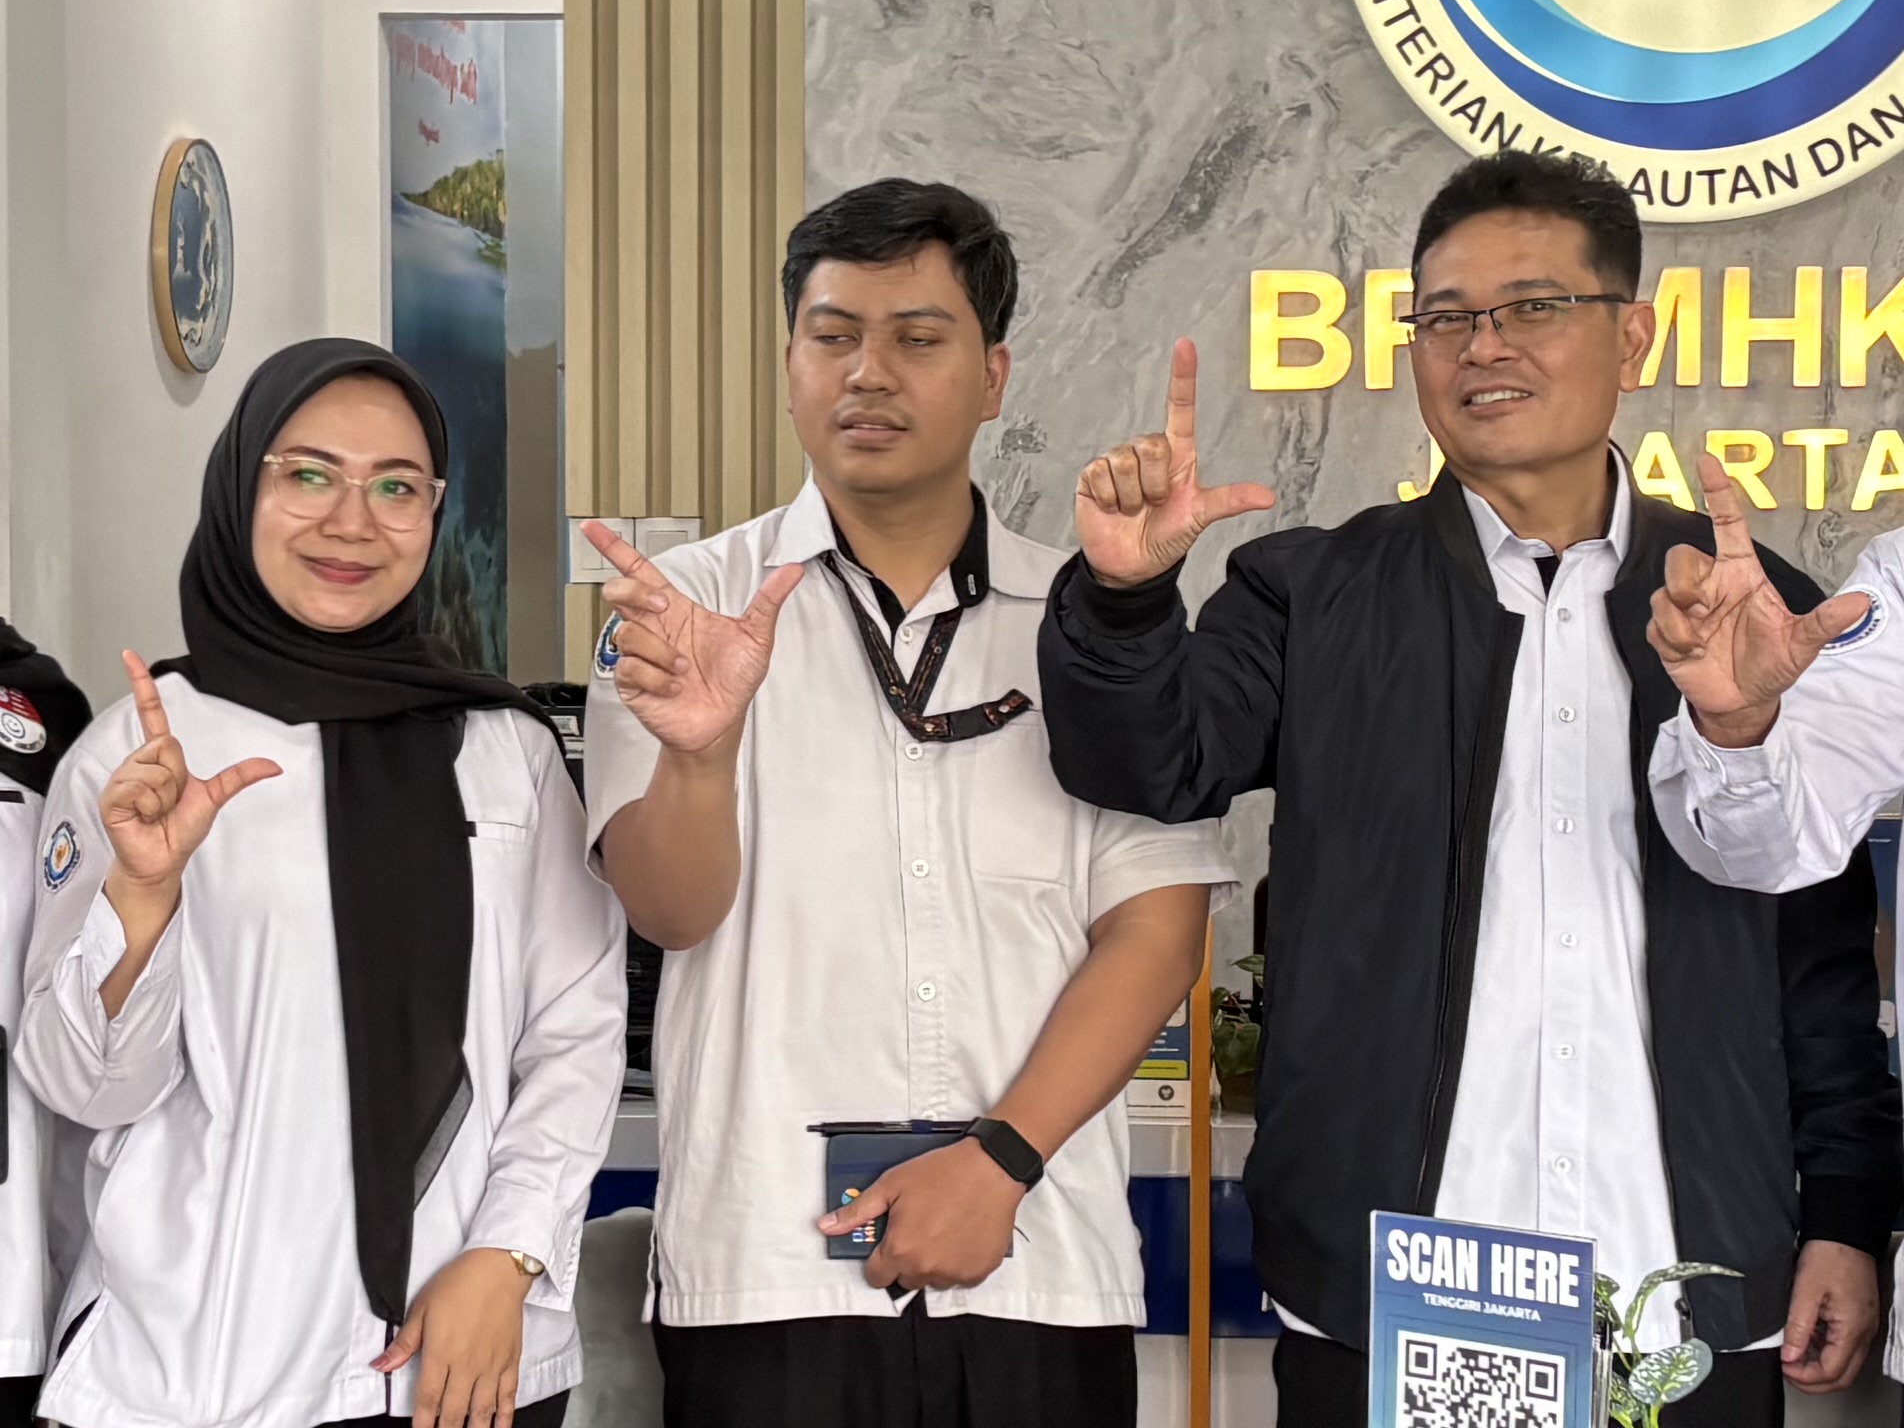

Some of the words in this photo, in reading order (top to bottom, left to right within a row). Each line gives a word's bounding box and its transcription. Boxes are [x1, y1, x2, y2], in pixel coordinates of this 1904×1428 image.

[1386, 1228, 1479, 1293] SCAN
[1490, 1242, 1581, 1308] HERE
[1483, 1302, 1542, 1323] JAKARTA
